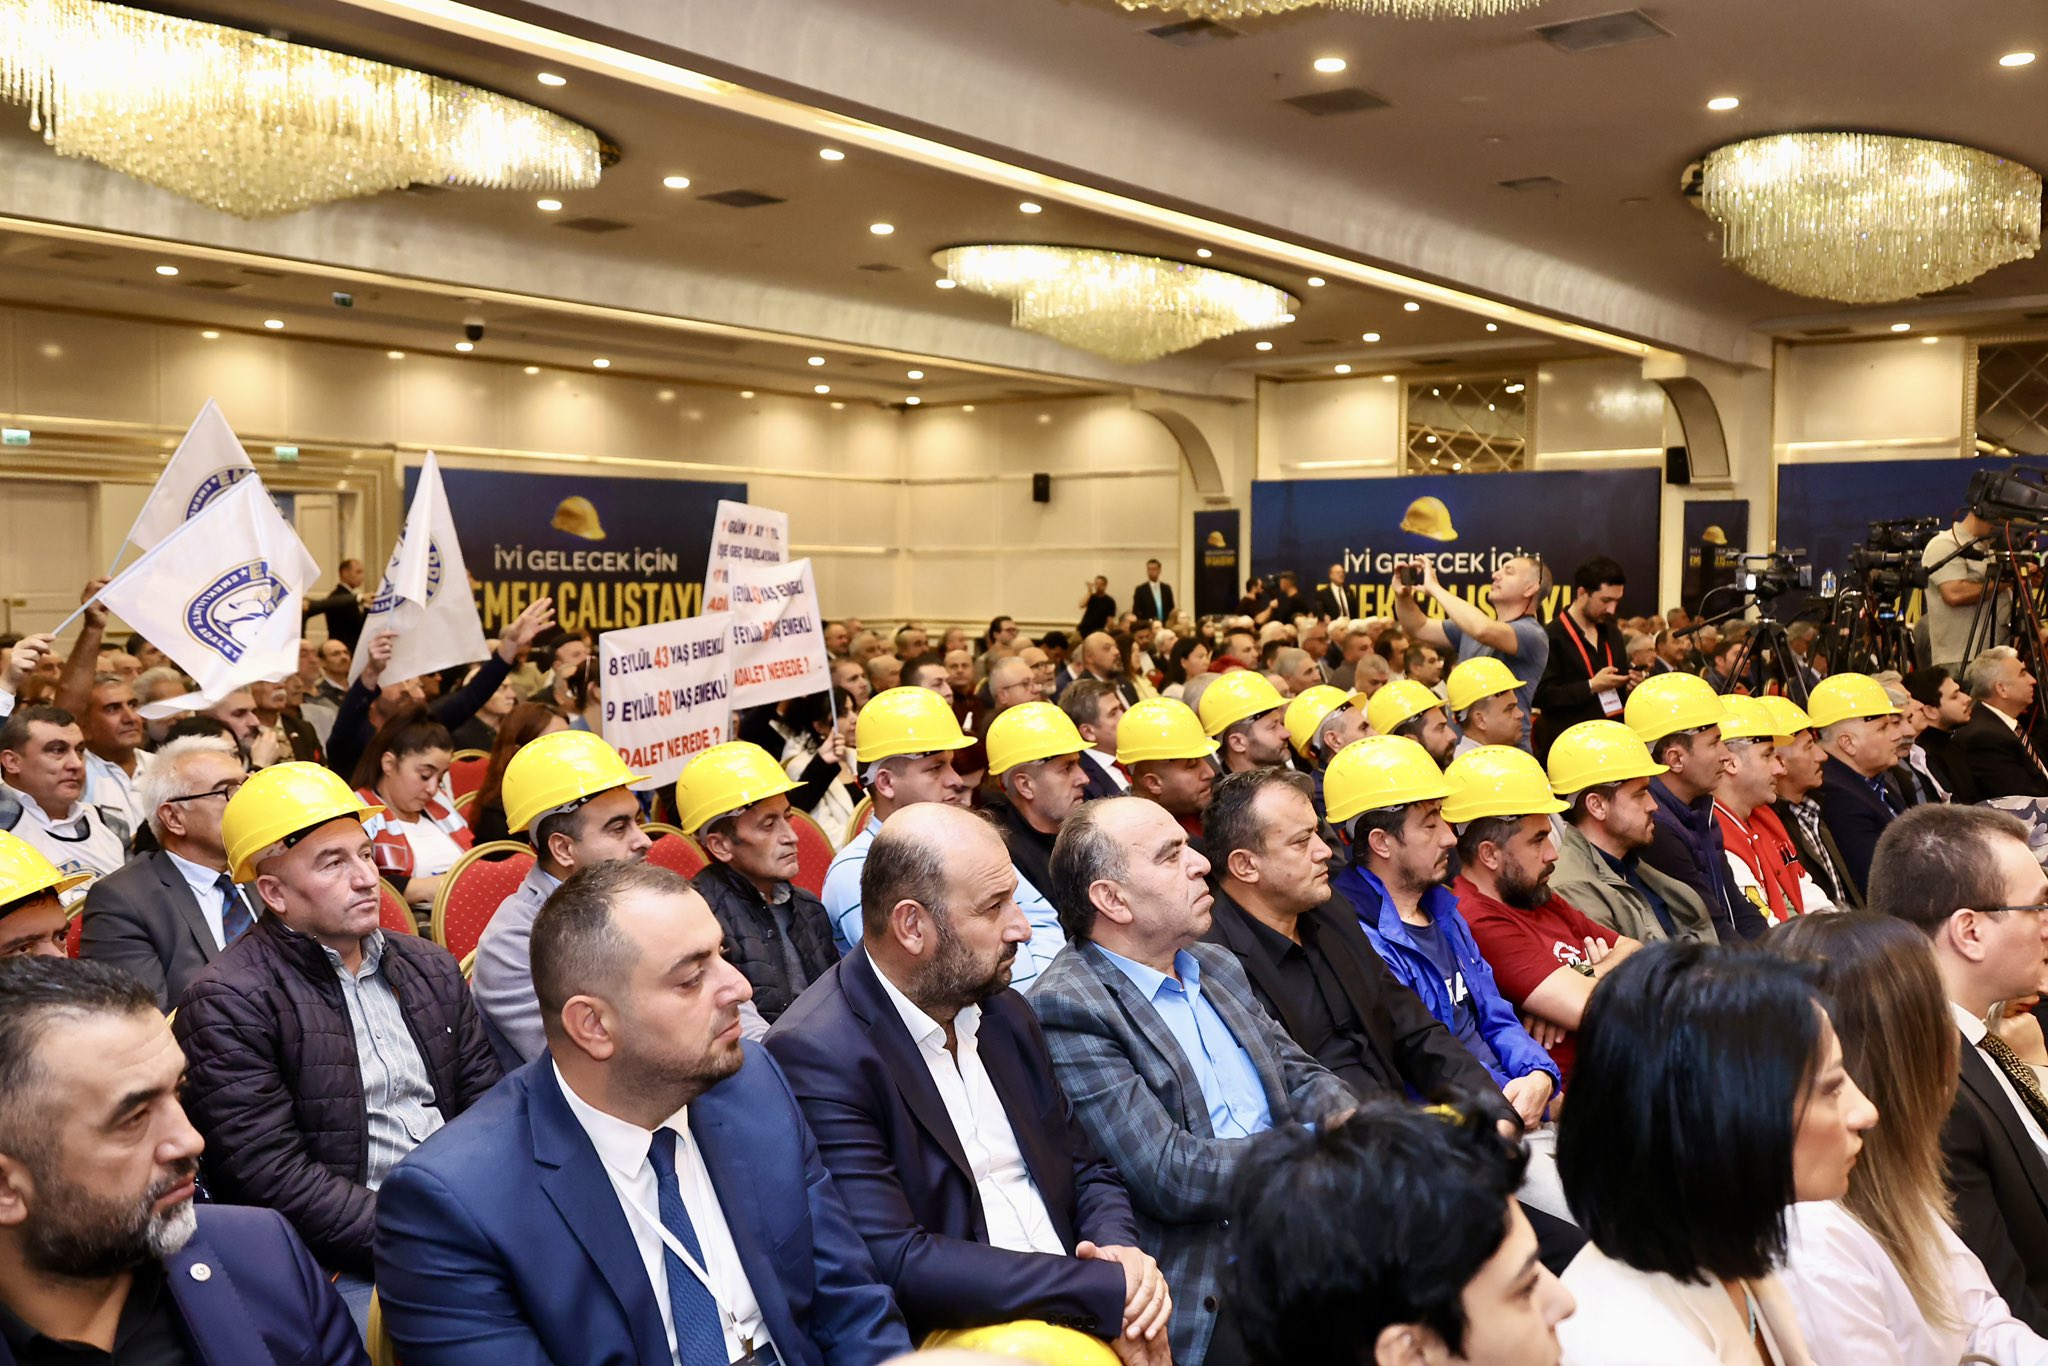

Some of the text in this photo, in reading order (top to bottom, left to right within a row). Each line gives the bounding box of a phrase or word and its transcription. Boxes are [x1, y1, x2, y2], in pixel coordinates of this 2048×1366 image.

[494, 544, 678, 576] İYİ GELECEK İÇİN
[1344, 547, 1371, 573] İYİ
[609, 631, 724, 675] 8 EYLÜL 43 YAŞ EMEKLİ
[767, 658, 803, 680] NEREDE
[606, 674, 727, 722] 9 EYLÜL 60 YAŞ EMEKLİ
[667, 729, 710, 760] NEREDE
